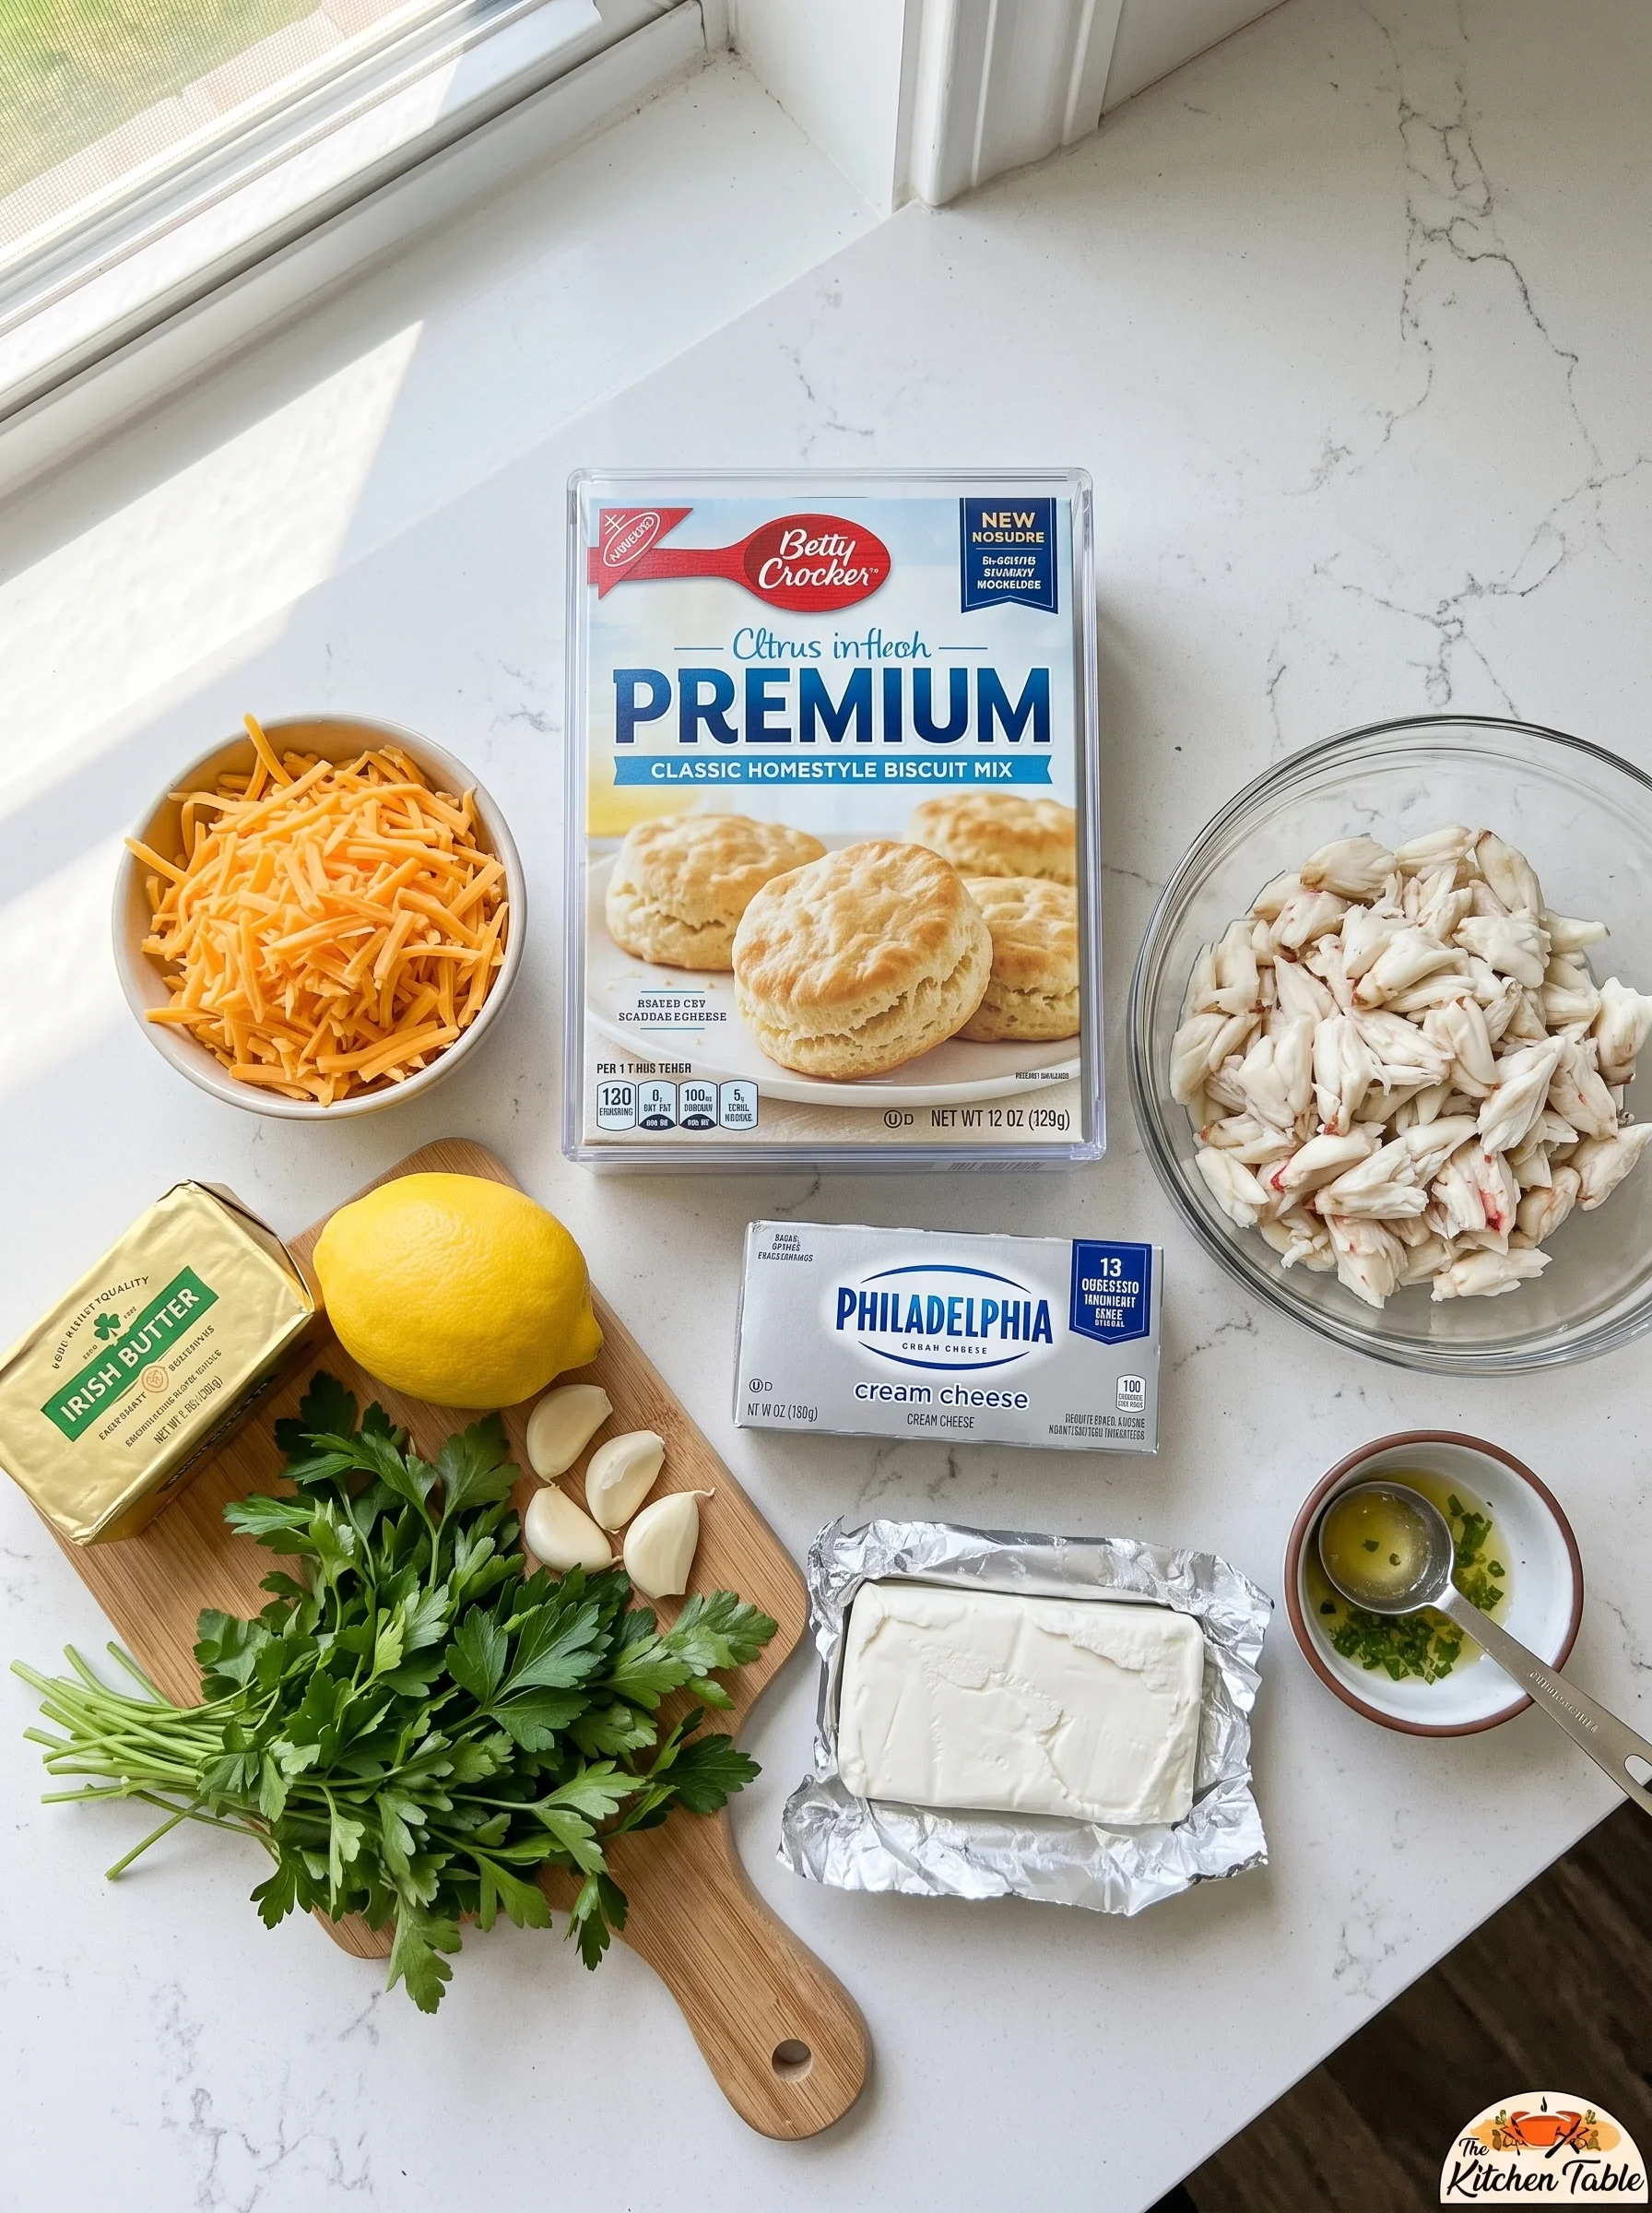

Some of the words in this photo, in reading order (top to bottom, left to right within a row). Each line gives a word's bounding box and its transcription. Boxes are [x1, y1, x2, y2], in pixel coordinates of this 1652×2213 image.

[982, 512, 1035, 528] NEW
[972, 531, 1044, 543] NOSUDRE
[779, 528, 856, 567] Betty
[758, 557, 869, 589] Crocker
[612, 668, 1050, 744] PREMIUM
[651, 762, 741, 779] CLASSIC
[748, 762, 878, 779] HOMESTYLE
[885, 762, 968, 779] BISCUIT
[974, 762, 1013, 778] MIX
[596, 1063, 616, 1074] PER
[931, 1109, 957, 1127] NET
[961, 1109, 984, 1127] WT
[987, 1109, 1002, 1127] 12
[1007, 1109, 1023, 1127] OZ
[1101, 1258, 1122, 1277] 13
[835, 1286, 1054, 1344] PHILADELPHIA
[60, 1362, 123, 1423] IRISH
[117, 1288, 200, 1368] BUTTER
[1123, 1379, 1141, 1393] 100
[855, 1383, 931, 1403] cream
[939, 1385, 1029, 1409] cheese
[907, 1413, 938, 1426] CREAM
[939, 1414, 975, 1428] CHEESE
